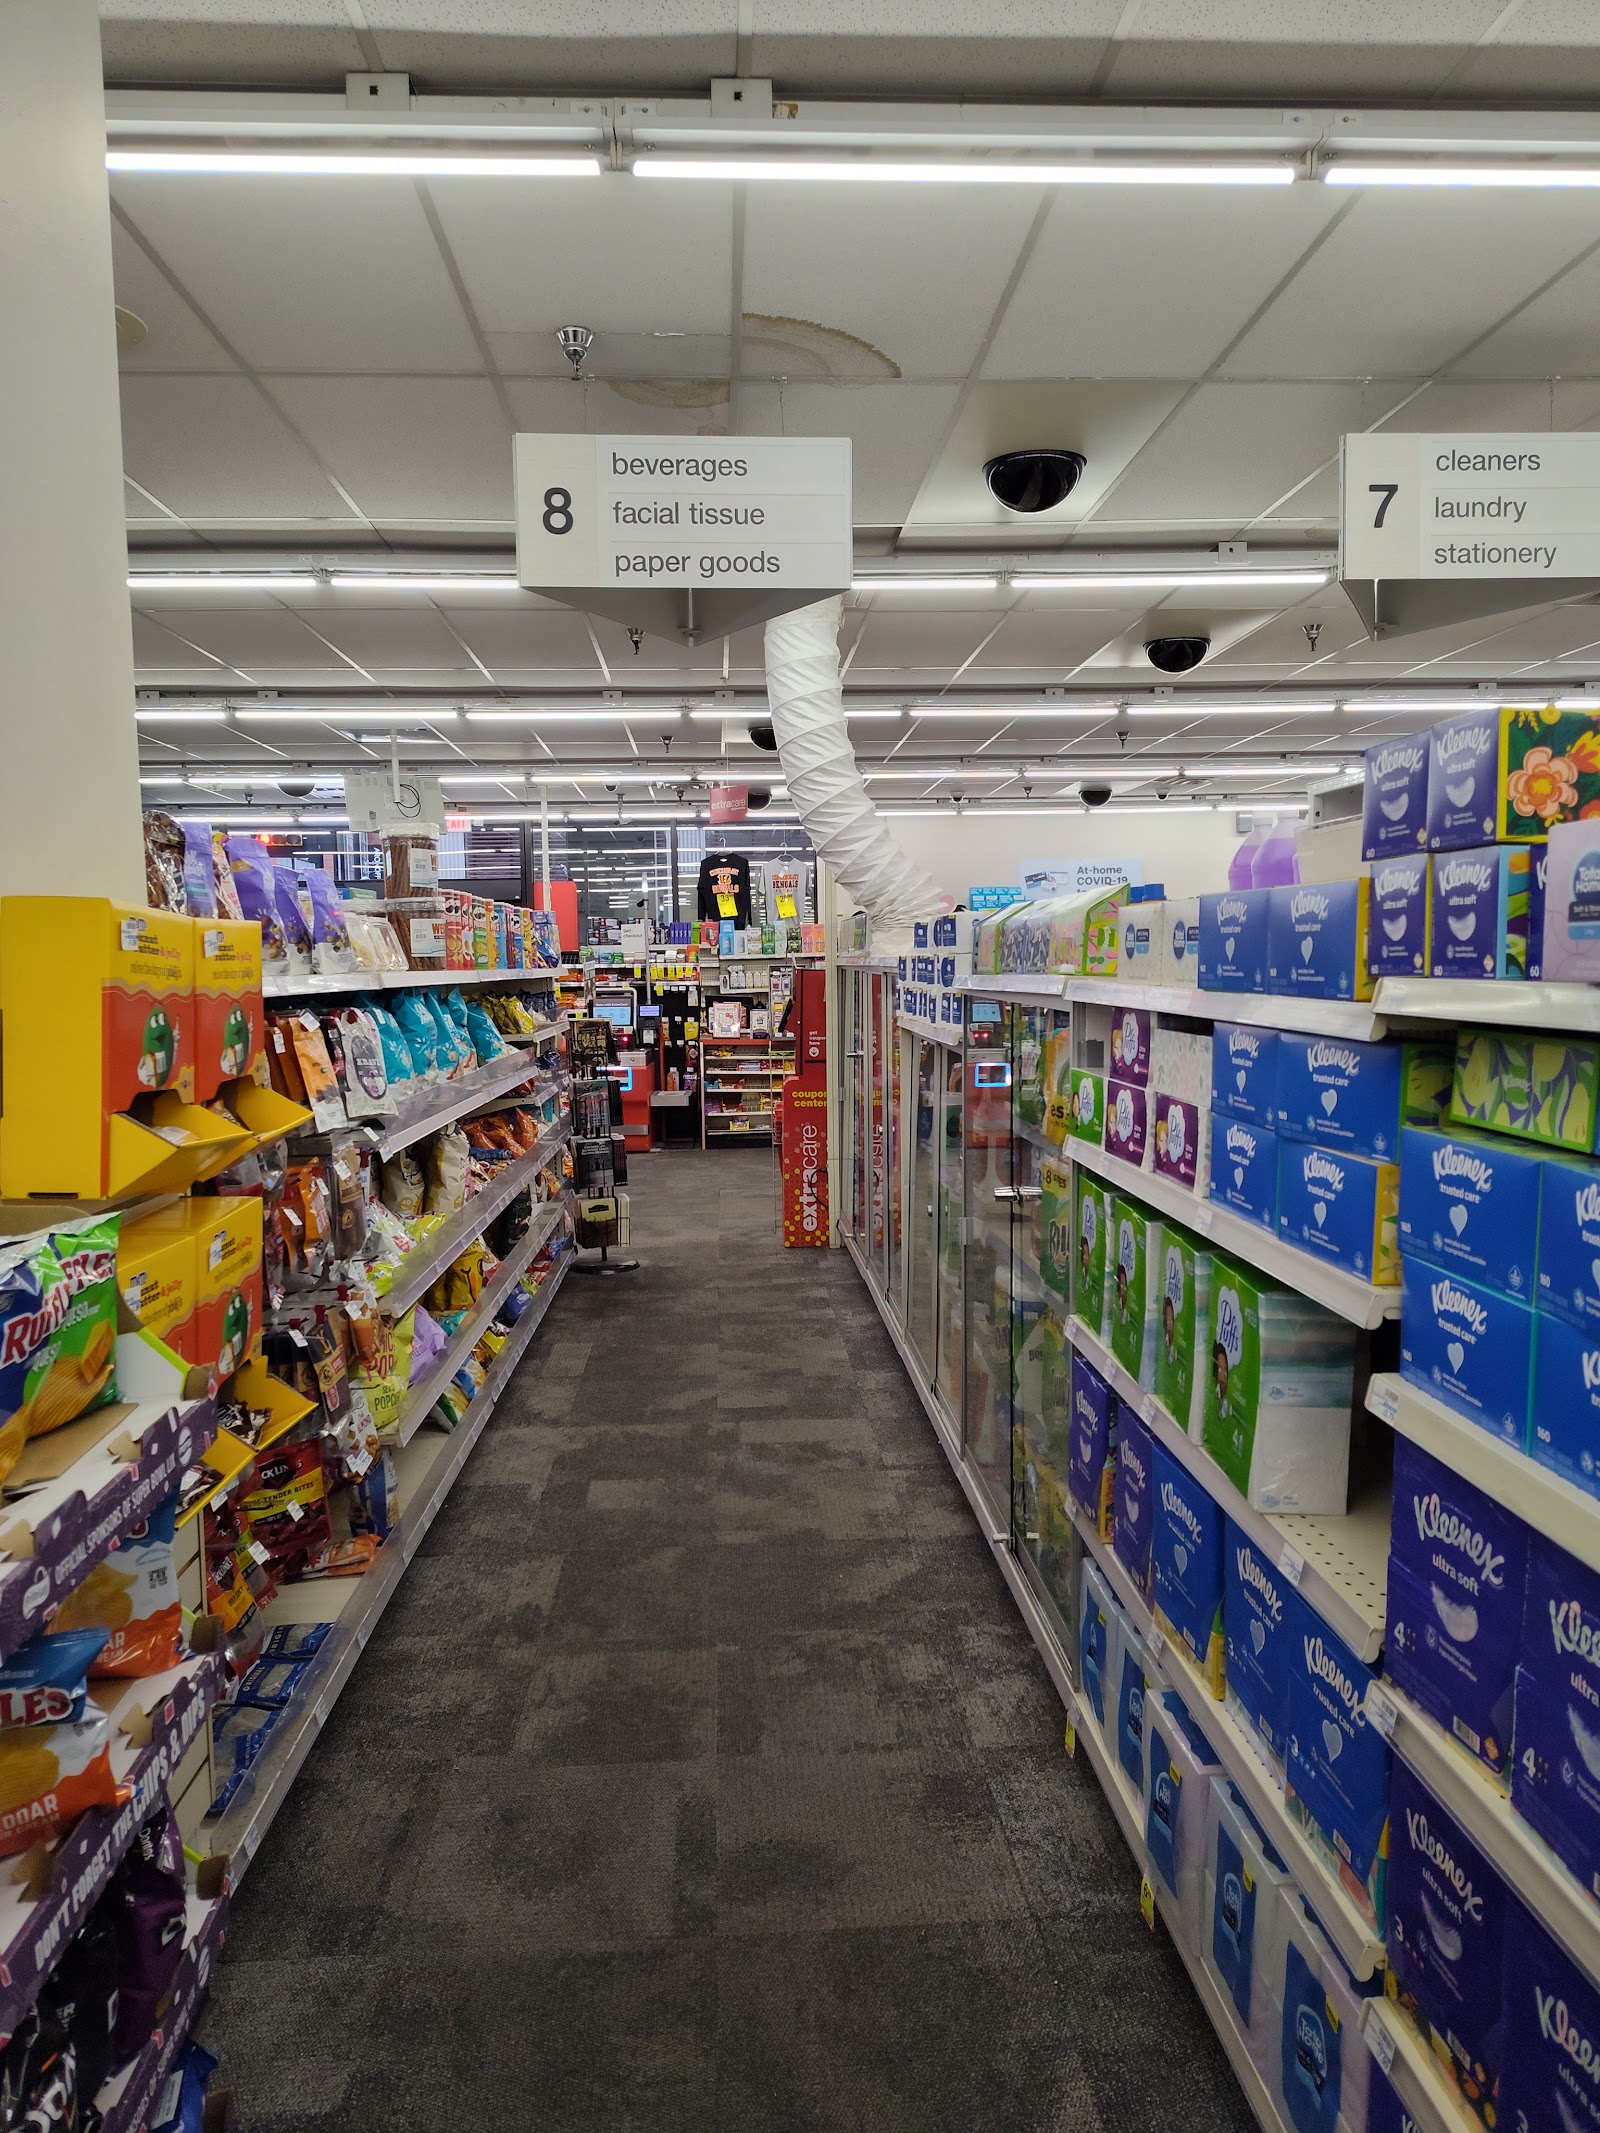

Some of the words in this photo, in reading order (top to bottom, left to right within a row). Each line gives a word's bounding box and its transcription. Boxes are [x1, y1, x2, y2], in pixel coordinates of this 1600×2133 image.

[612, 452, 748, 482] beverages
[1436, 449, 1541, 472] cleaners
[542, 487, 574, 535] 8
[613, 501, 679, 525] facial
[689, 502, 765, 526] tissue
[1369, 484, 1398, 528] 7
[1435, 496, 1527, 523] laundry
[615, 553, 690, 578] paper
[699, 551, 781, 578] goods
[1434, 542, 1557, 569] stationery
[1437, 728, 1491, 766] Kleenex
[1371, 748, 1424, 784] Kleenex
[1463, 758, 1476, 771] soft
[711, 798, 746, 810] extracare
[1431, 837, 1440, 848] 60
[1077, 866, 1123, 875] At-home
[1077, 876, 1128, 886] COVID-19
[1375, 866, 1420, 901] Kleenex
[1439, 861, 1491, 896] Kleenex
[1576, 881, 1600, 893] Hom
[1217, 897, 1247, 925] Kleenex
[1291, 890, 1329, 923] Kleenex
[1530, 966, 1540, 977] 60
[1123, 1022, 1136, 1053] Puffs
[1229, 1029, 1260, 1058] Kleenex
[1308, 1041, 1360, 1075] Kleenex
[1313, 1073, 1334, 1085] trusted
[1334, 1076, 1350, 1087] care
[1081, 1085, 1093, 1114] Puffs
[1118, 1098, 1131, 1129] Puffs
[1278, 1110, 1288, 1121] 160
[1168, 1114, 1182, 1149] Puffs
[1227, 1125, 1256, 1156] Kleenex
[801, 1125, 818, 1232] extracare
[1304, 1152, 1345, 1191] Kleenex
[1432, 1144, 1493, 1192] Kleenex
[1307, 1183, 1323, 1198] trusted
[1323, 1188, 1336, 1201] care
[1439, 1183, 1462, 1200] trusted
[1462, 1190, 1480, 1204] care
[1083, 1204, 1095, 1243] Puffs
[1400, 1221, 1412, 1233] 160
[1121, 1229, 1134, 1271] Puffs
[1167, 1257, 1182, 1303] Puffs
[1539, 1272, 1550, 1288] 160
[1431, 1279, 1488, 1335] Kleenex
[1220, 1299, 1239, 1353] Puffs
[1438, 1317, 1458, 1336] trusted
[1458, 1327, 1476, 1345] care
[1402, 1348, 1412, 1362] 160
[1076, 1389, 1098, 1432] Kleenex
[1537, 1426, 1550, 1443] 160
[1120, 1439, 1146, 1489] Kleenex
[264, 1489, 293, 1504] TENDER
[294, 1480, 315, 1493] BITES
[1161, 1482, 1202, 1544] Kleenex
[1167, 1517, 1185, 1542] trusted
[1185, 1536, 1196, 1555] care
[1413, 1493, 1504, 1586] Kleenex
[1155, 1561, 1161, 1580] 3
[1237, 1547, 1284, 1622] Kleenex
[1432, 1553, 1456, 1581] ultra
[1457, 1572, 1479, 1597] soft
[1244, 1588, 1262, 1617] trusted
[1262, 1614, 1275, 1633] care
[1228, 1637, 1235, 1657] 3
[1394, 1621, 1405, 1648] 4
[1304, 1635, 1366, 1728] Kleenex
[1570, 1672, 1600, 1708] ultra
[1313, 1683, 1338, 1719] trusted
[1338, 1715, 1355, 1739] care
[1291, 1734, 1299, 1757] 3
[1522, 1748, 1535, 1778] 4
[71, 1833, 111, 1913] FORGET
[112, 1801, 133, 1846] THE
[134, 1745, 168, 1820] CHIPS
[170, 1728, 180, 1764] &
[181, 1687, 205, 1746] DIPS
[138, 1826, 155, 1863] Doritos
[1406, 1807, 1483, 1922] Kleenex
[1422, 1867, 1443, 1899] ultra
[1443, 1894, 1463, 1925] soft
[1558, 2063, 1588, 2106] ultra
